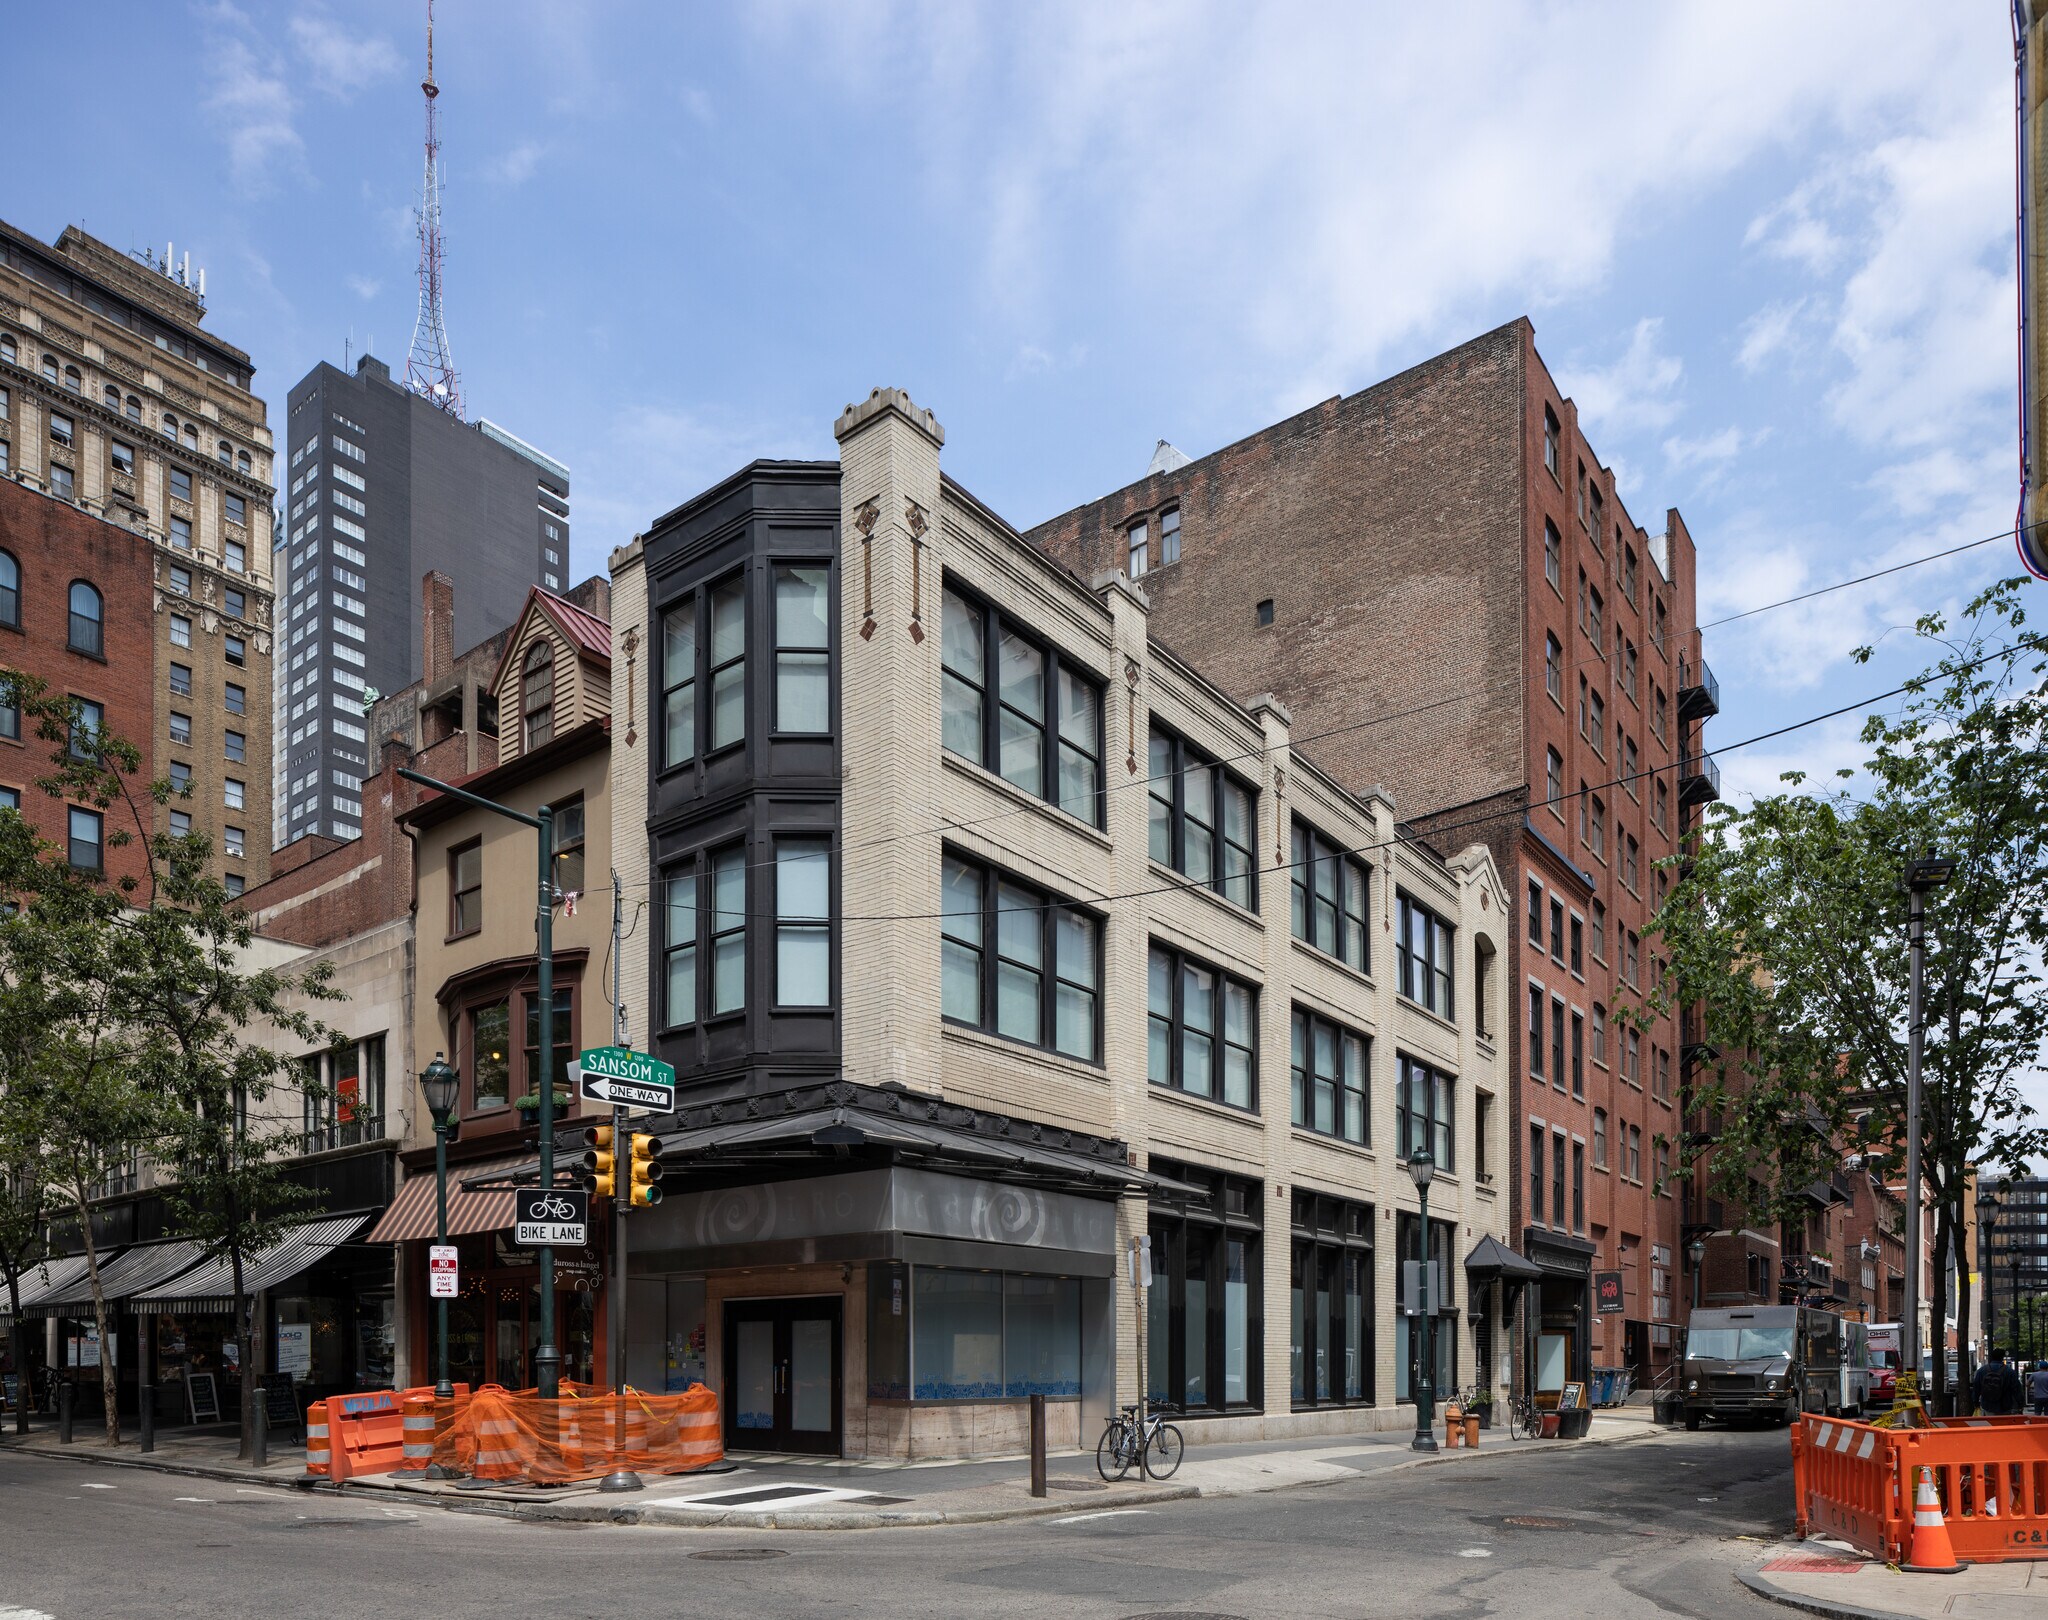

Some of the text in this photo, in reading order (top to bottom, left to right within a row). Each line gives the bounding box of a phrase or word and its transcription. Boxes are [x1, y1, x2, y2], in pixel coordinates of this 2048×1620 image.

[613, 1050, 624, 1058] 1300
[626, 1052, 632, 1060] W
[588, 1054, 668, 1083] SANSOM ST
[609, 1085, 663, 1103] ONE WAY
[520, 1226, 582, 1240] BIKE LANE
[344, 1394, 393, 1412] VEOLIA
[2013, 1530, 2027, 1543] C
[2031, 1530, 2042, 1542] &
